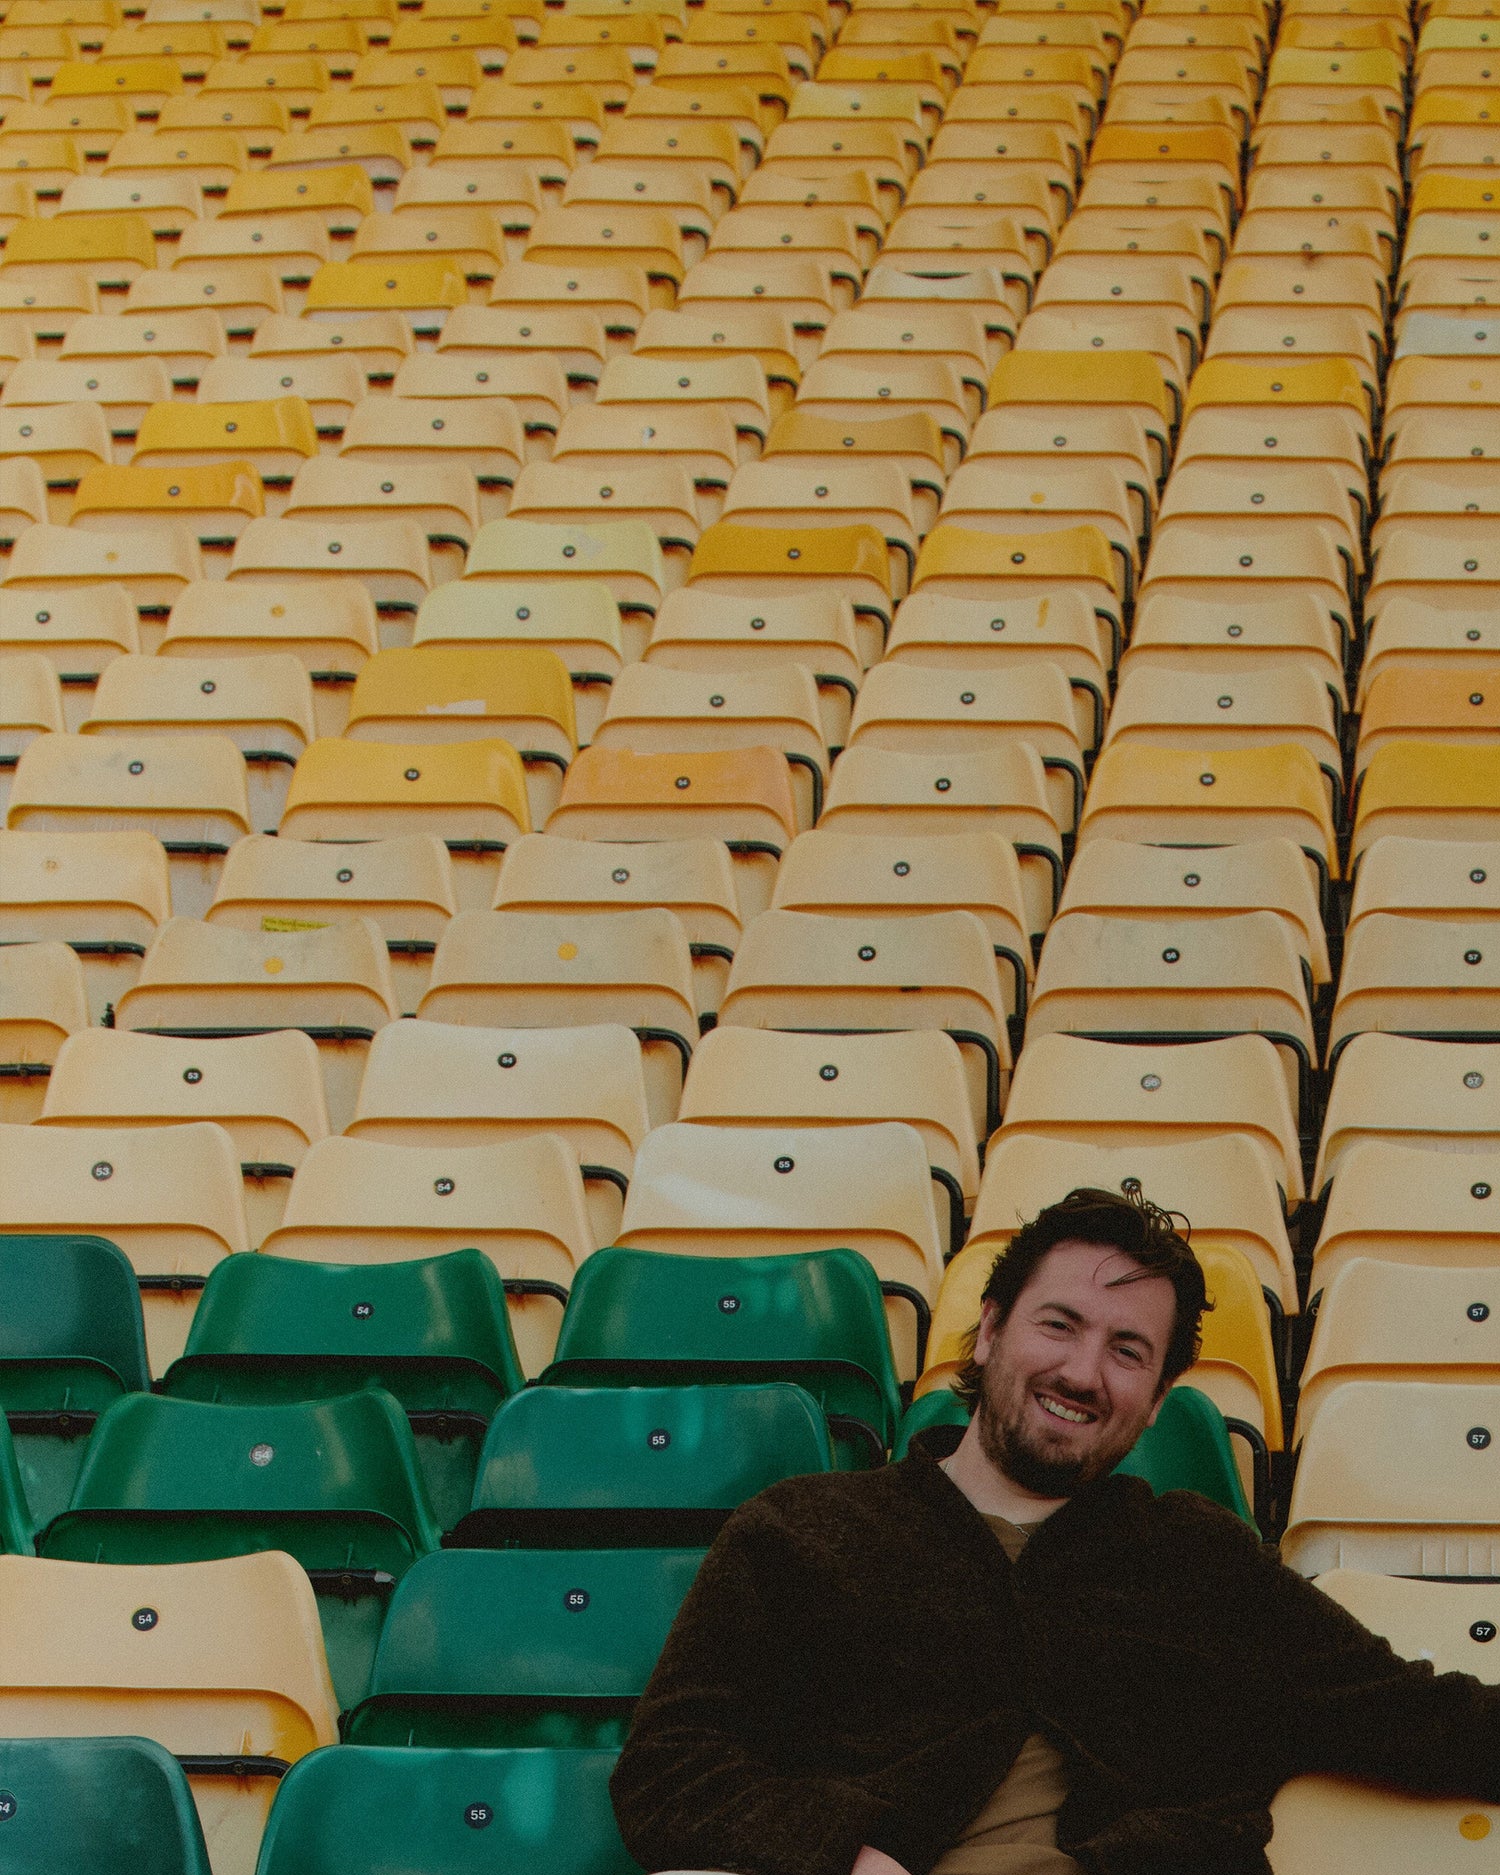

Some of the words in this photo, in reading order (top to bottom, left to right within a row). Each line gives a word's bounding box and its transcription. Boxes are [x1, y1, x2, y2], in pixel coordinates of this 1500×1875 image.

[1144, 1079, 1157, 1087] 56
[1468, 1076, 1479, 1084] 57
[96, 1167, 110, 1176] 53
[436, 1183, 450, 1191] 54
[724, 1300, 735, 1308] 55
[1472, 1308, 1483, 1316] 57
[653, 1435, 665, 1445] 55
[1472, 1435, 1485, 1443] 57
[254, 1451, 269, 1459] 54
[570, 1595, 583, 1604] 55
[139, 1614, 152, 1624] 54
[1476, 1627, 1490, 1635] 57
[471, 1810, 486, 1820] 55
